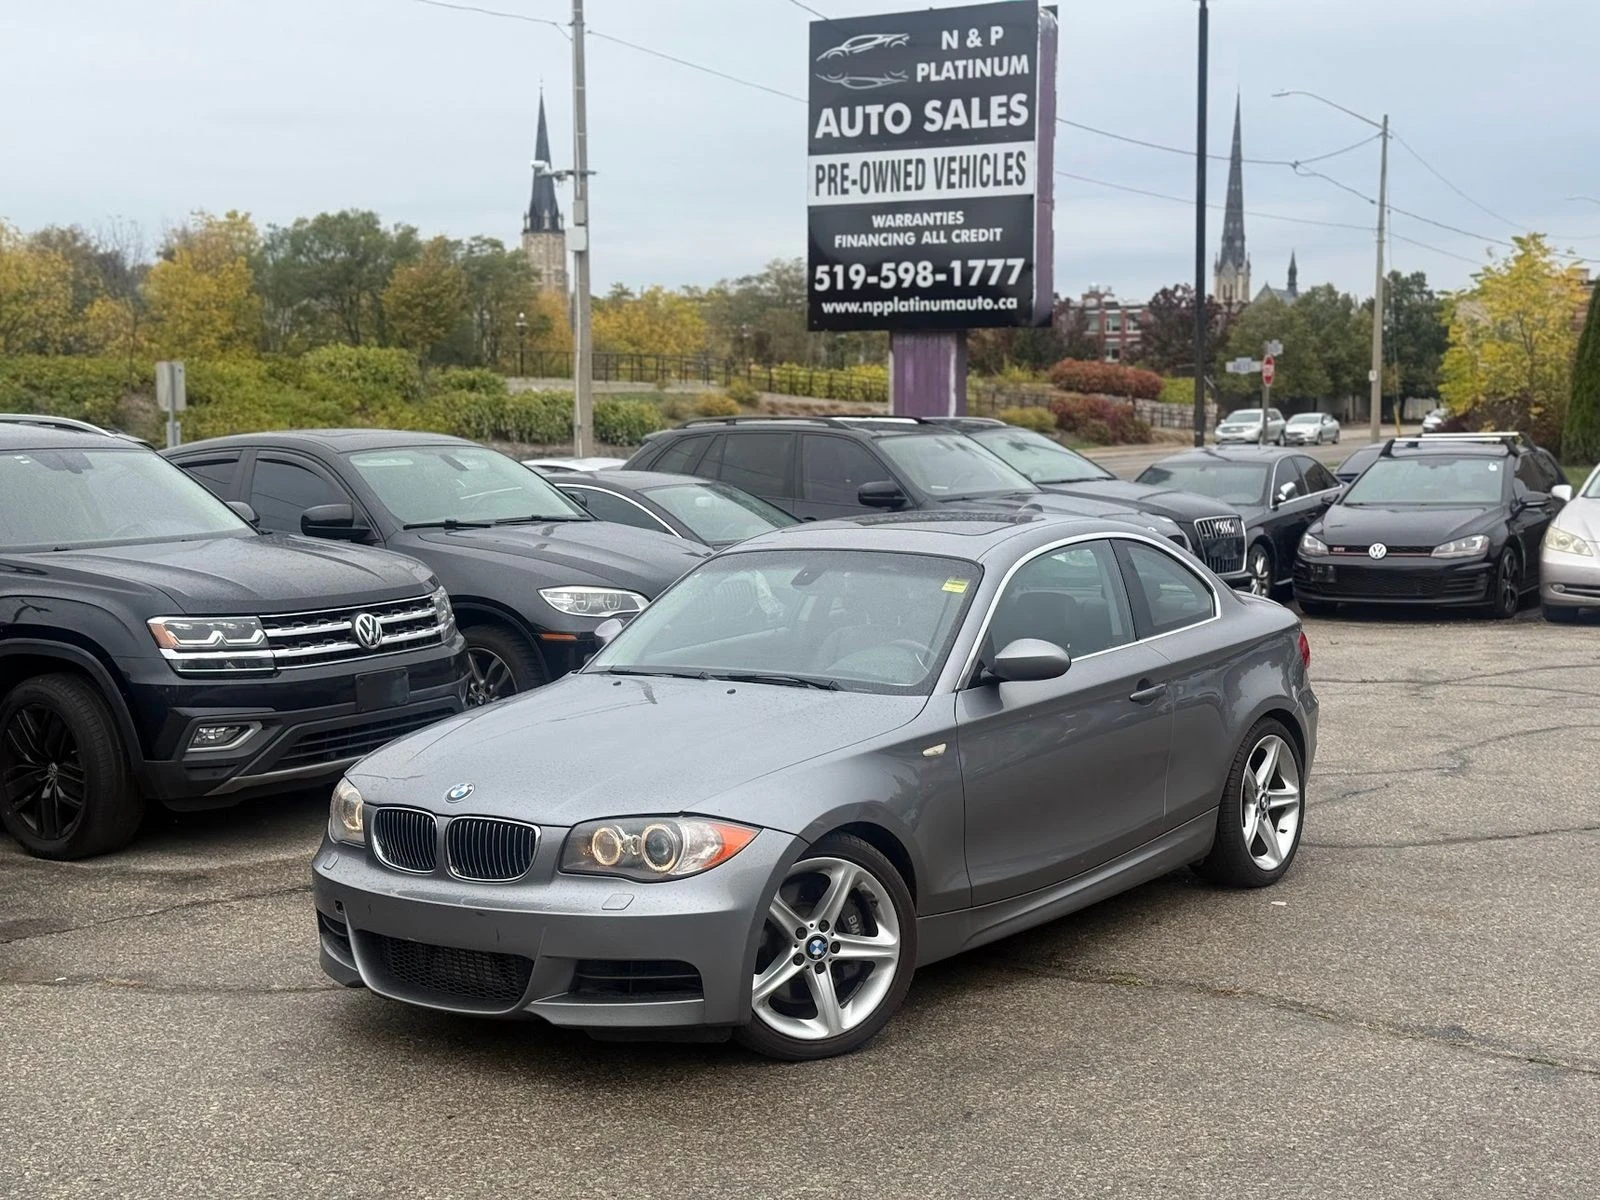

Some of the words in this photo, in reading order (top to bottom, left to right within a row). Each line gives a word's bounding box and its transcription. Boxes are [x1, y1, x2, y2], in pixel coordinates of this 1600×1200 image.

[941, 30, 959, 50] N
[967, 28, 983, 48] &
[990, 26, 1004, 46] P
[916, 54, 1029, 82] PLATINUM
[814, 102, 912, 139] AUTO
[923, 93, 1029, 132] SALES
[815, 158, 926, 197] PRE-OWNED
[934, 151, 1027, 190] VEHICLES
[872, 211, 965, 228] WARRANTIES
[834, 231, 916, 248] FINANCING
[921, 231, 947, 244] ALL
[951, 228, 1003, 243] CREDIT
[814, 258, 1026, 292] 519-598-1777
[822, 297, 1018, 316] www.npplatinumauto.ca
[848, 914, 861, 935] BM
